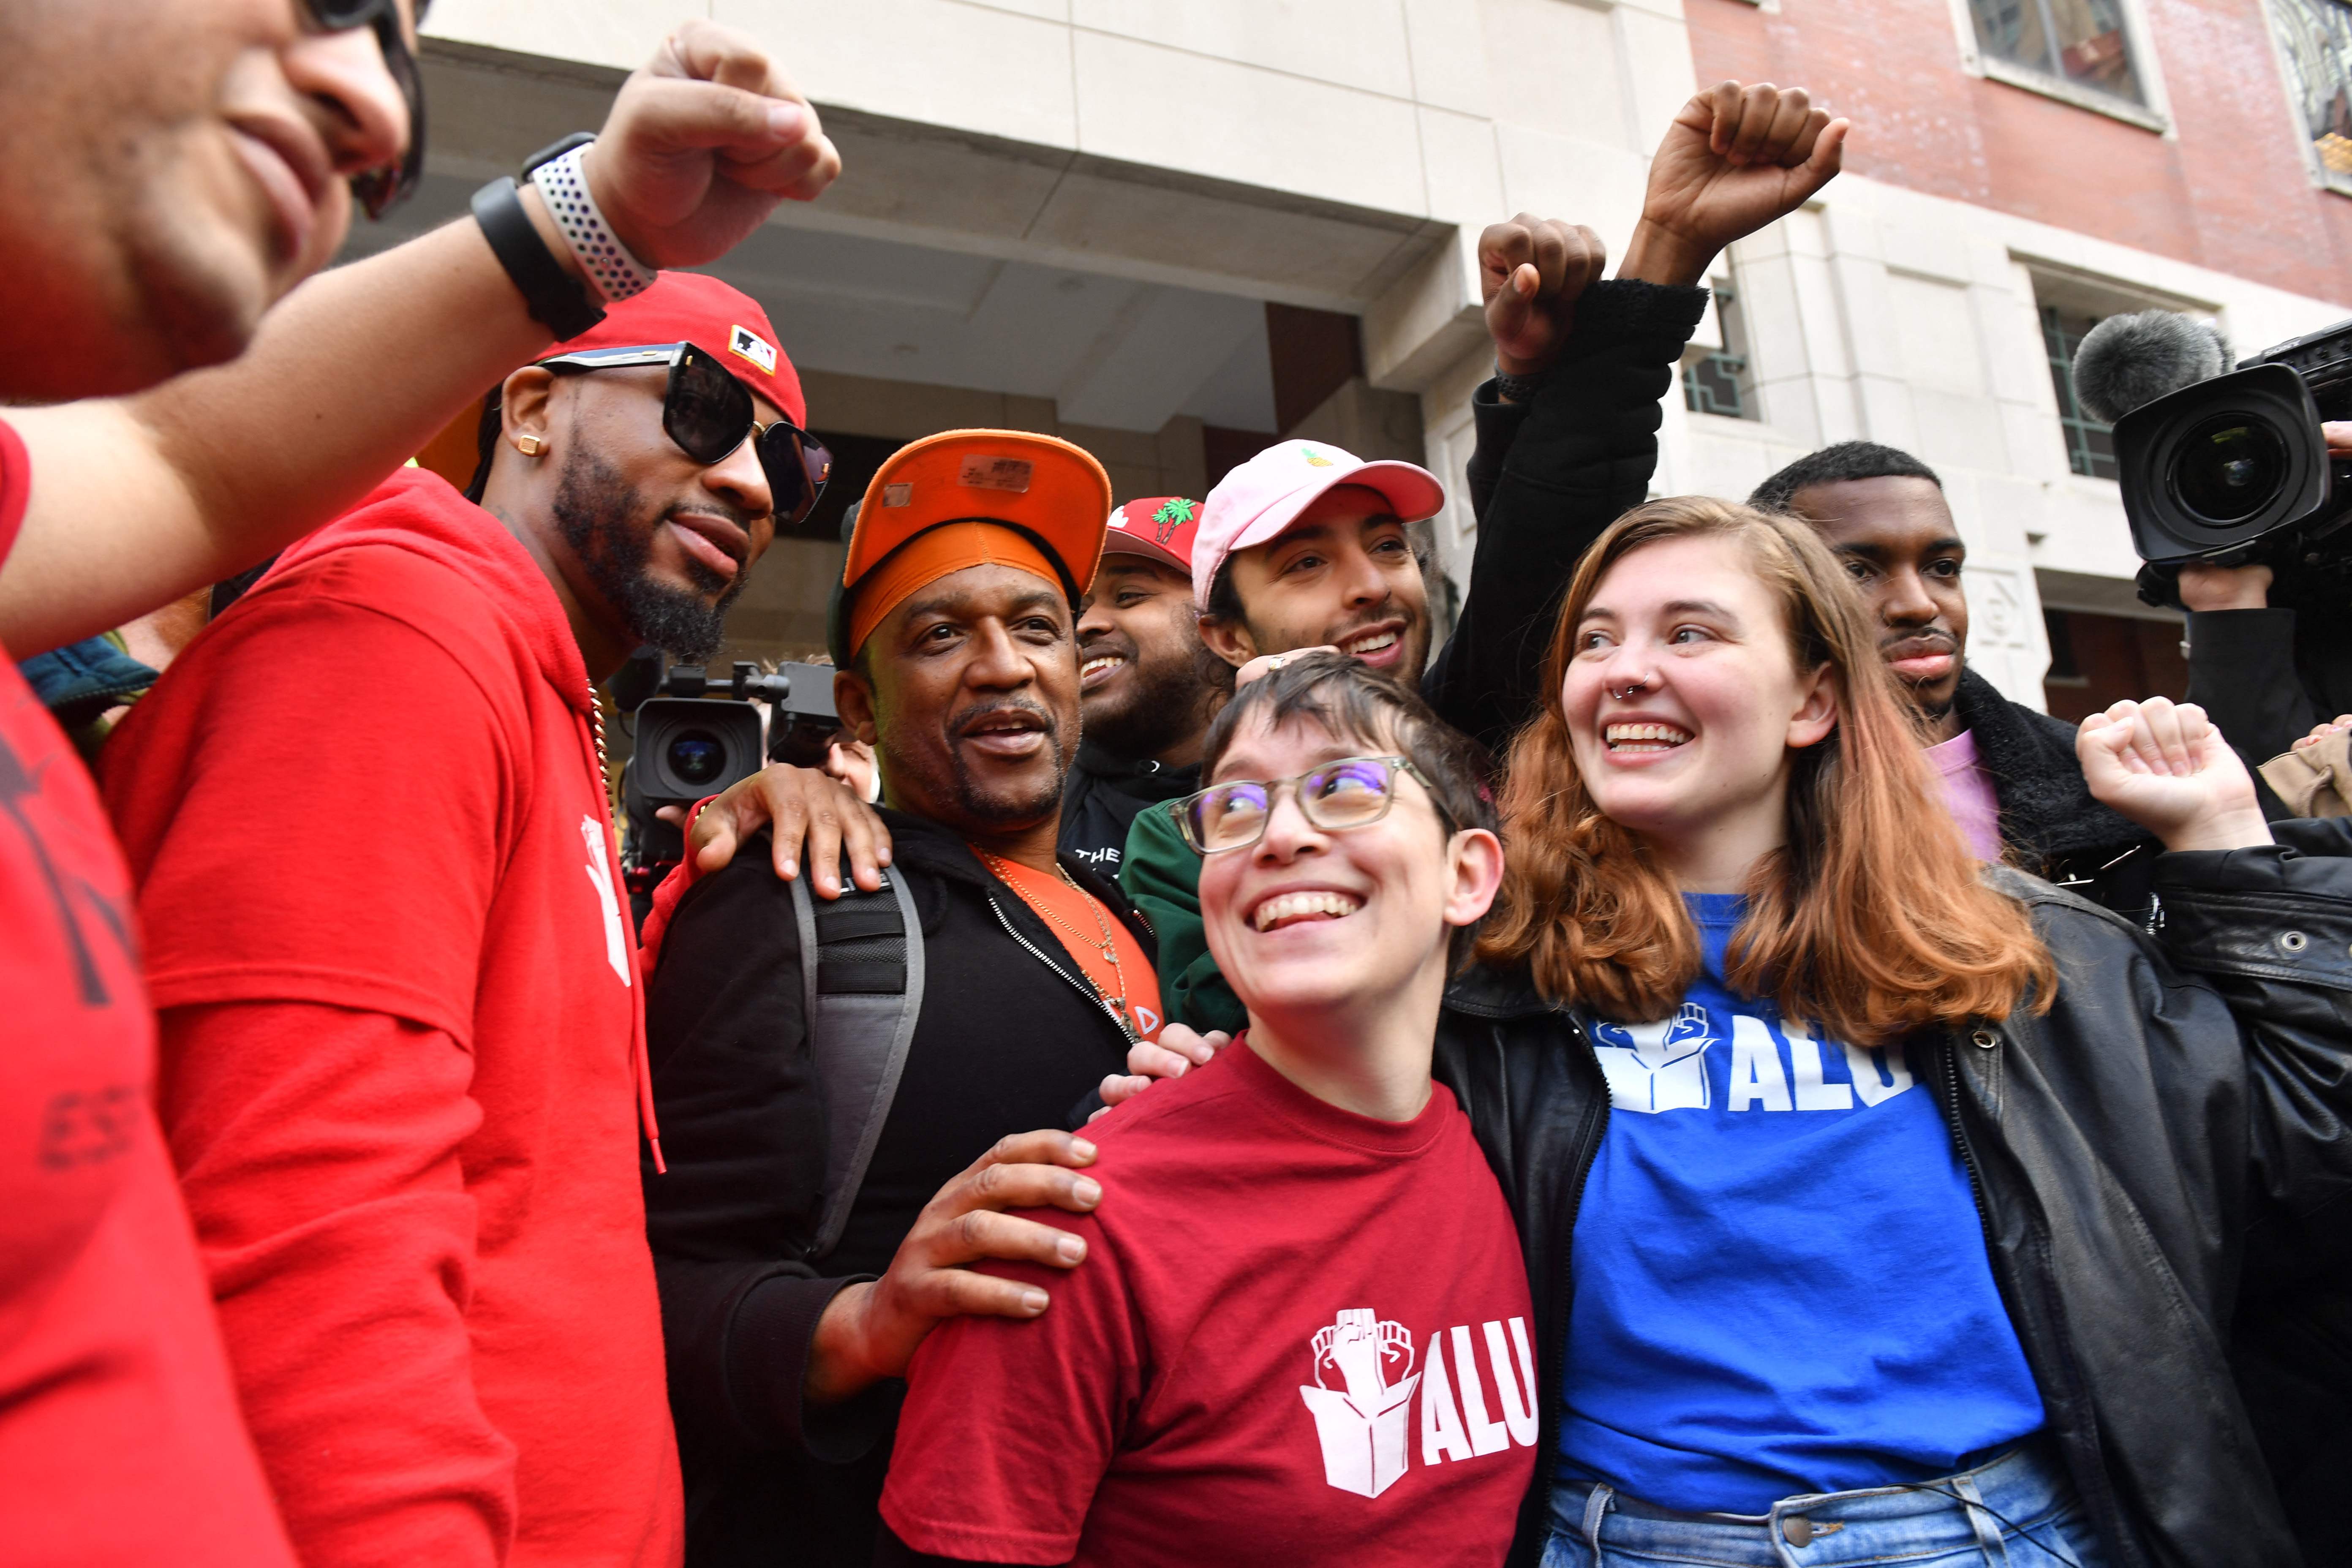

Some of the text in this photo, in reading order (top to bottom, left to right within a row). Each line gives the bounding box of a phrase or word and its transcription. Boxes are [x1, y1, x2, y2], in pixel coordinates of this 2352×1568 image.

[2264, 339, 2301, 357] SONY
[1075, 847, 1121, 863] THE
[1727, 1014, 1914, 1112] ALU
[1421, 1316, 1539, 1466] ALU
